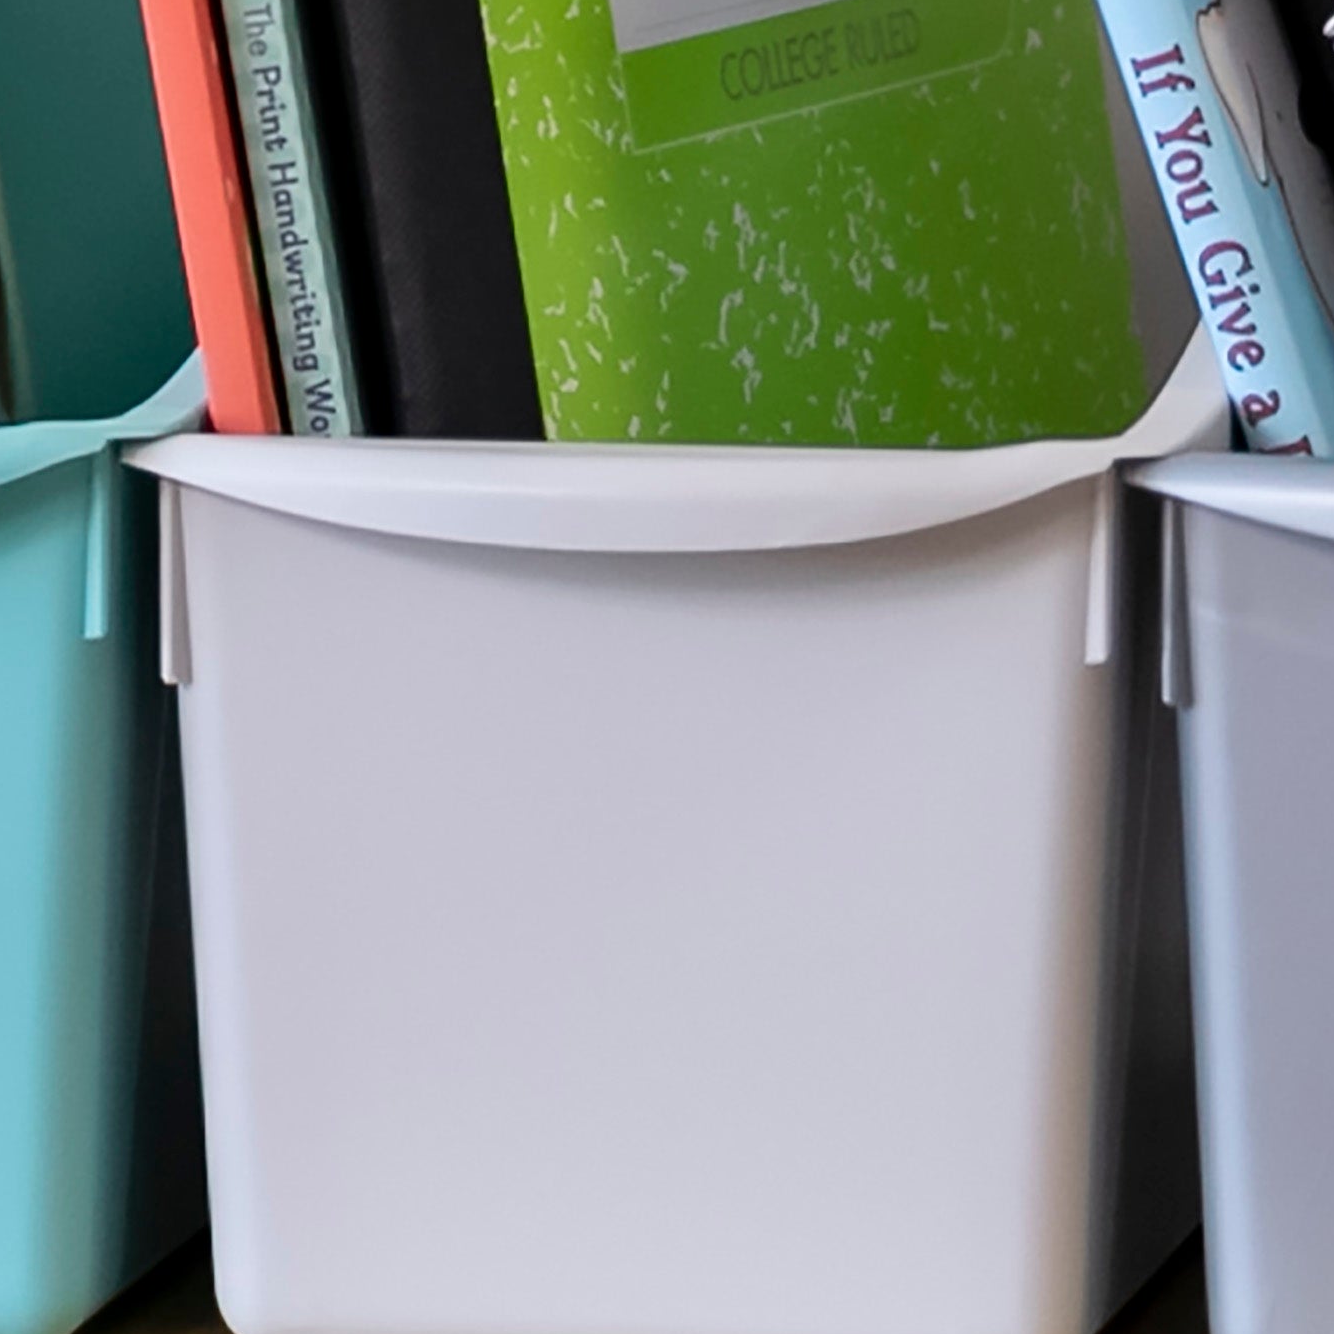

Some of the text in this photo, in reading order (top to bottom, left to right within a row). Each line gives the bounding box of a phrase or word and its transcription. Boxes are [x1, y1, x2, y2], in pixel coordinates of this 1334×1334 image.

[243, 2, 337, 438] The Print Handwriting Wo
[719, 7, 922, 102] COLLEGE RULED
[1129, 43, 1282, 427] If You Give a
